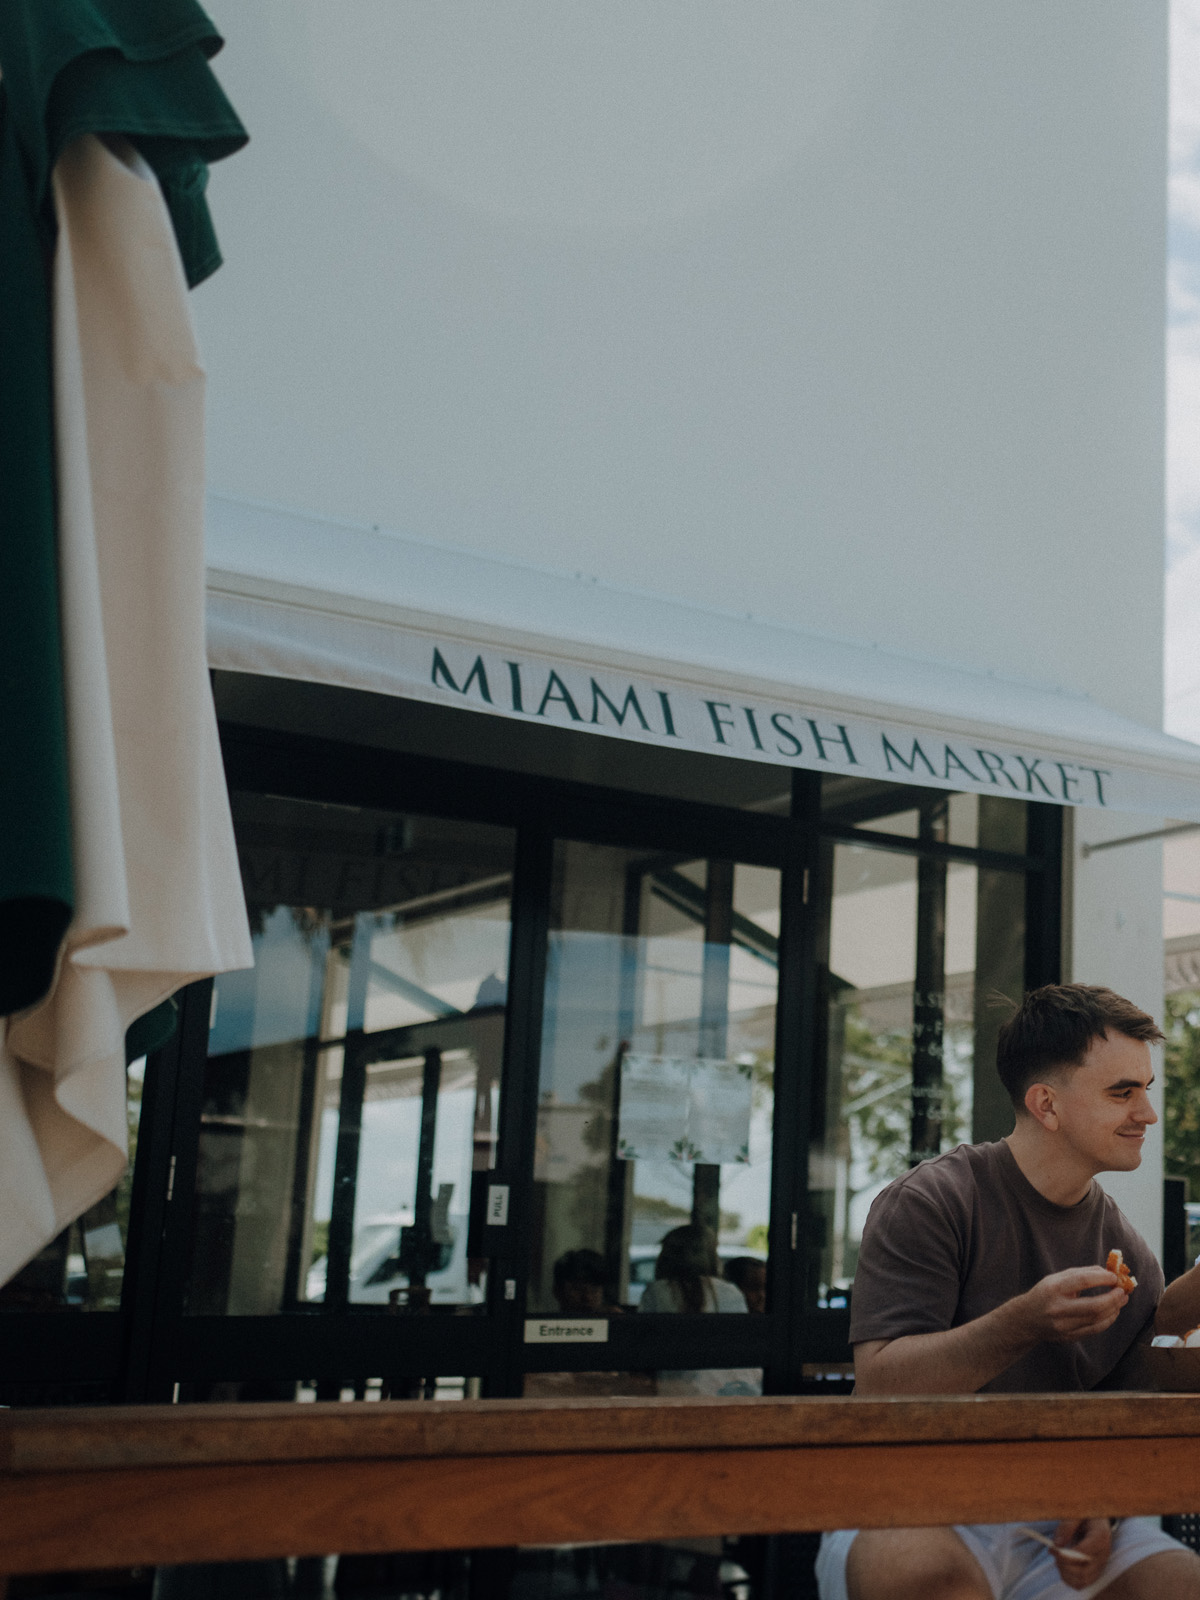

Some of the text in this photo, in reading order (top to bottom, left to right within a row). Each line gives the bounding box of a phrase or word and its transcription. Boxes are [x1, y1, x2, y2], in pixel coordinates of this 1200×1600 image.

[431, 646, 1112, 806] MIAMI FISH MARKET
[493, 1194, 503, 1218] PULL
[539, 1324, 594, 1337] Entrance
